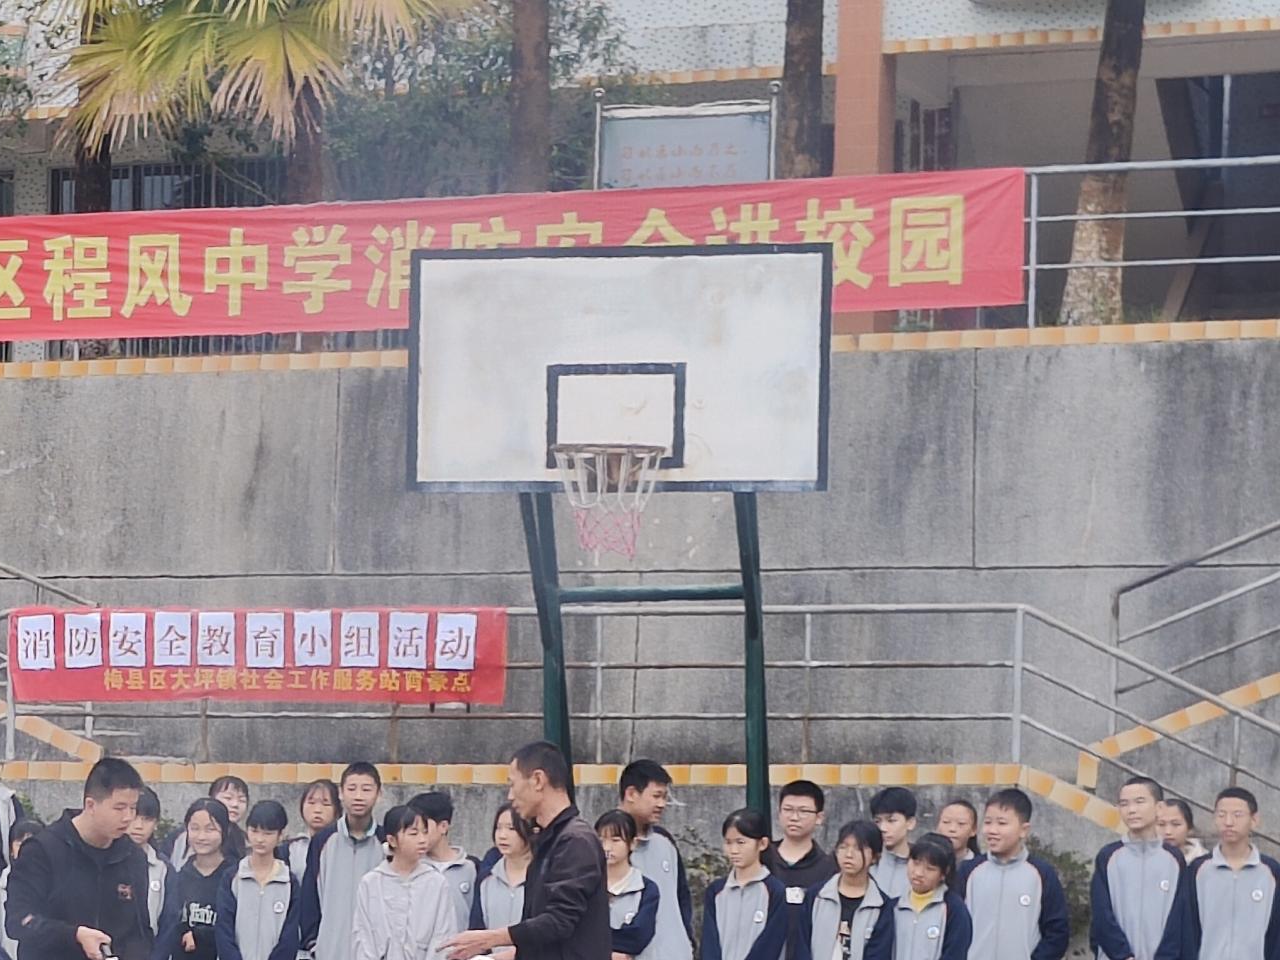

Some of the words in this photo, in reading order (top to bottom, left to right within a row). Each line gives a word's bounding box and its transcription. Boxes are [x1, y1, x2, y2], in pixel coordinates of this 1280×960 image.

[21, 625, 474, 660] 消防安全教育小组活动
